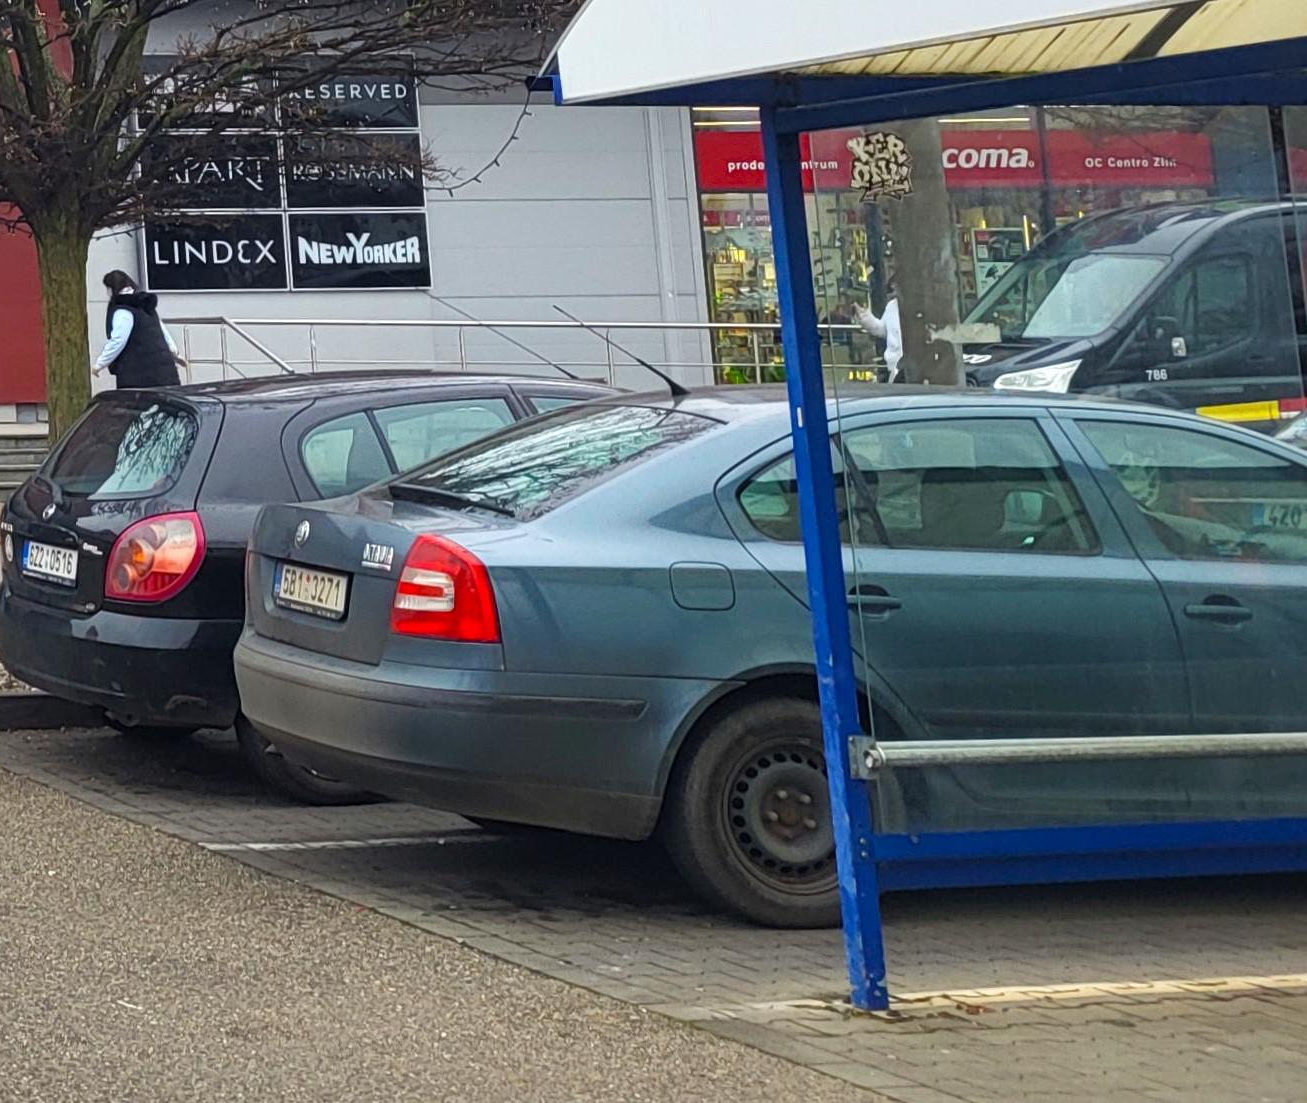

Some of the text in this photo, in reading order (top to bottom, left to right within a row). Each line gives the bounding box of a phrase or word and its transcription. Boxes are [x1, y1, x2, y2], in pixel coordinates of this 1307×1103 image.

[728, 161, 838, 173] prode ntrum
[942, 148, 1029, 169] coma
[1085, 157, 1103, 168] OC
[1107, 157, 1149, 168] Centro
[49, 549, 73, 576] 0516
[282, 568, 342, 608] 5B1 3271
